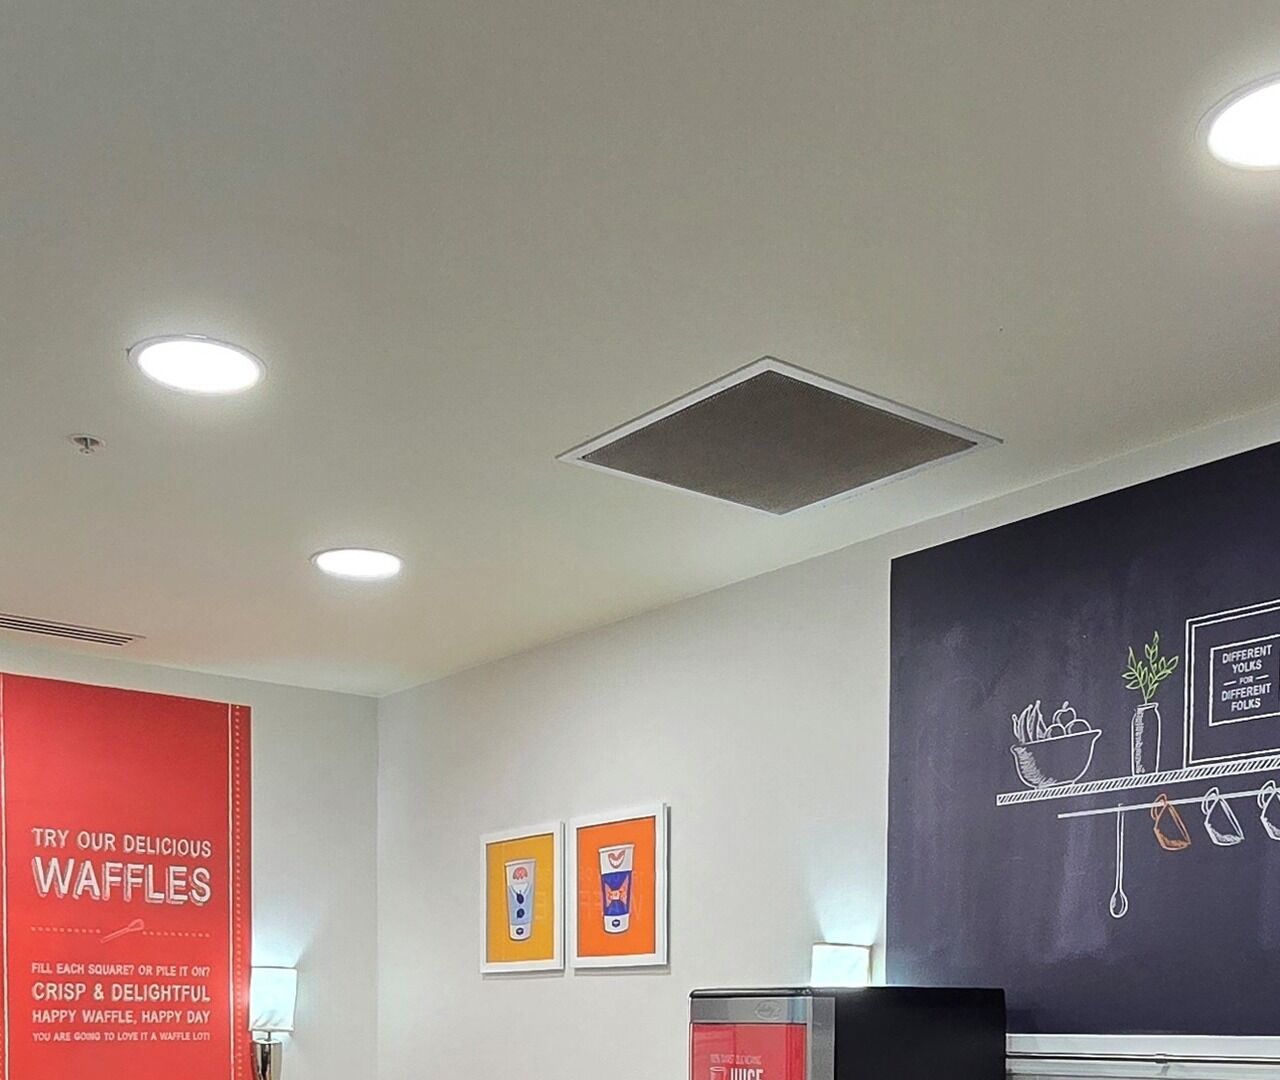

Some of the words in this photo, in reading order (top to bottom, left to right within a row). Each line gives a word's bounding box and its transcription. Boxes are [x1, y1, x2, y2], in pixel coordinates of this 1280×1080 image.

[1222, 644, 1272, 664] DIFFERENT
[1232, 659, 1262, 674] YOLKS
[1239, 675, 1253, 685] FOR
[1221, 683, 1271, 701] DIFFERENT
[1231, 698, 1261, 712] FOLKS
[31, 827, 69, 848] TRY
[76, 831, 116, 851] OUR
[123, 834, 212, 858] DELICIOUS
[31, 856, 211, 906] WAFFLES
[31, 962, 52, 974] FILL
[56, 963, 84, 975] EACH
[88, 964, 134, 976] SQUARE?
[138, 965, 153, 976] OR
[156, 966, 176, 977] PILE
[179, 966, 188, 976] IT
[191, 966, 210, 977] ON?
[31, 982, 86, 1001] CRISP
[93, 982, 104, 1001] &
[111, 983, 210, 1002] DELIGHTFUL
[32, 1009, 77, 1024] HAPPY
[82, 1009, 137, 1025] WAFFLE,
[141, 1010, 182, 1024] HAPPY
[187, 1010, 210, 1024] DAY
[32, 1032, 50, 1042] YOU
[53, 1032, 70, 1041] ARE
[73, 1032, 100, 1041] GOING
[104, 1032, 115, 1041] TO
[117, 1032, 139, 1041] LOVE
[140, 1032, 148, 1041] IT
[150, 1032, 157, 1041] A
[160, 1032, 190, 1041] WAFFLE
